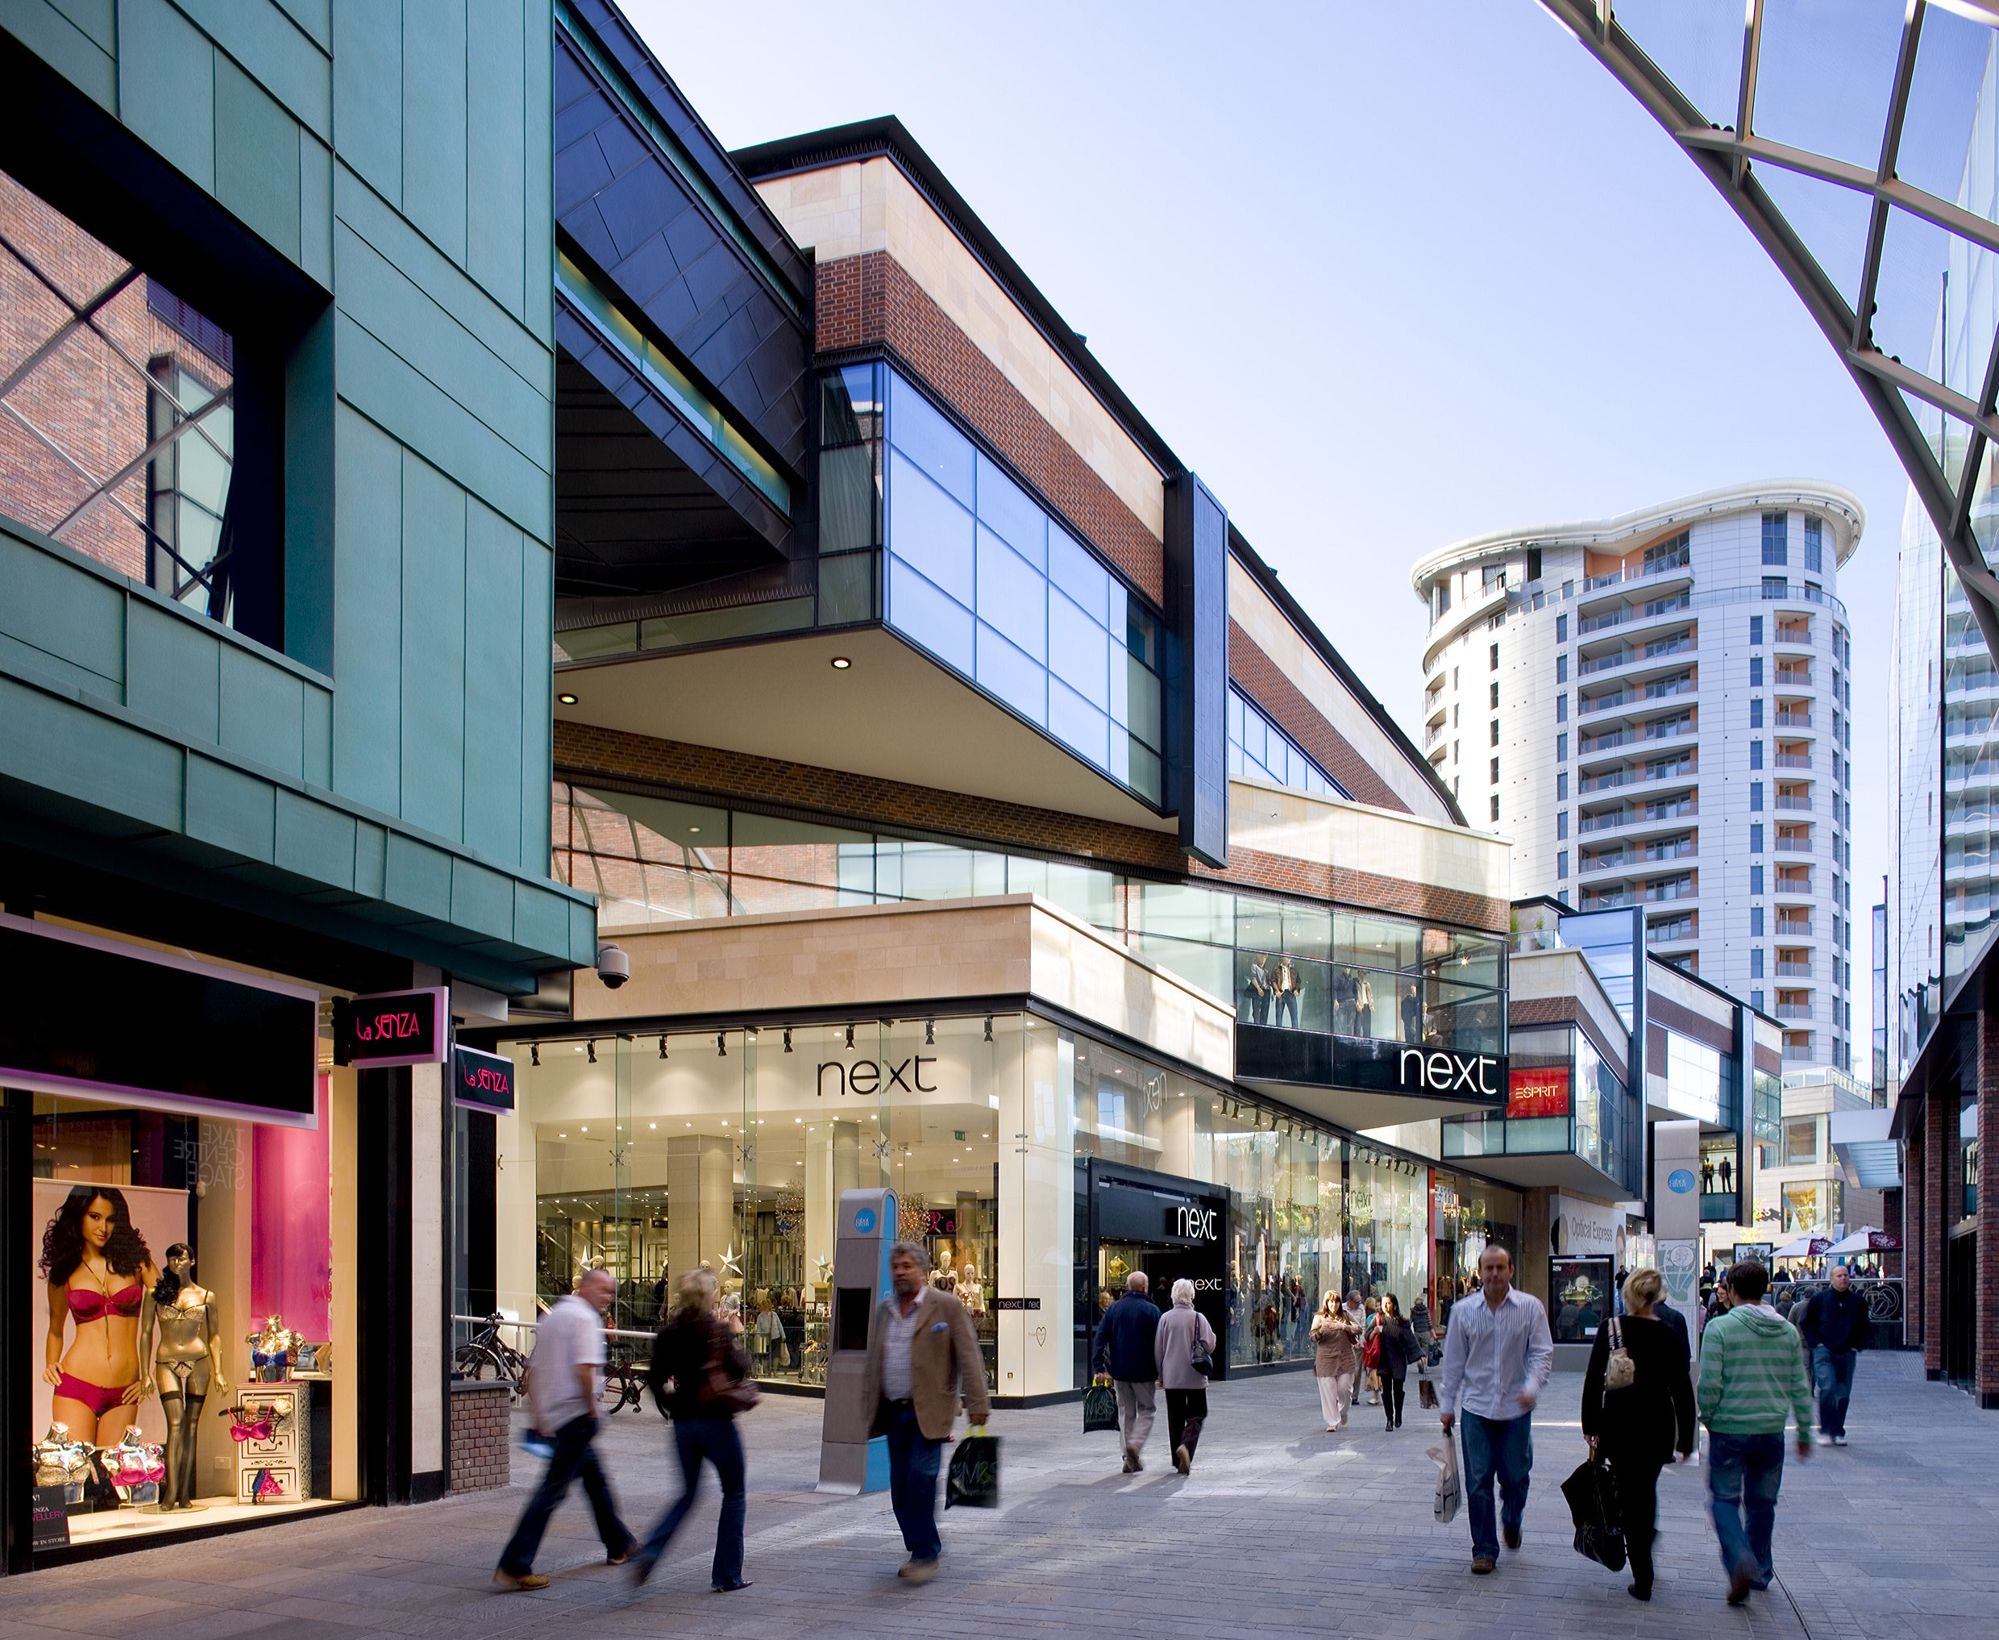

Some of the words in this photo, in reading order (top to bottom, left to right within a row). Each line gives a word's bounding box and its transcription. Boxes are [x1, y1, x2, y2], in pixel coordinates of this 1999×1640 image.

[356, 1017, 372, 1040] La
[374, 1012, 420, 1040] SENZA
[464, 1064, 476, 1087] La
[477, 1068, 509, 1094] SENZA
[817, 1055, 938, 1096] next
[1400, 1049, 1497, 1095] next
[1515, 1085, 1559, 1099] ESPRIT
[1178, 1206, 1217, 1240] next
[1571, 1216, 1592, 1241] Optical
[1593, 1221, 1613, 1244] Express
[1193, 1278, 1222, 1291] ext
[998, 1301, 1023, 1309] next
